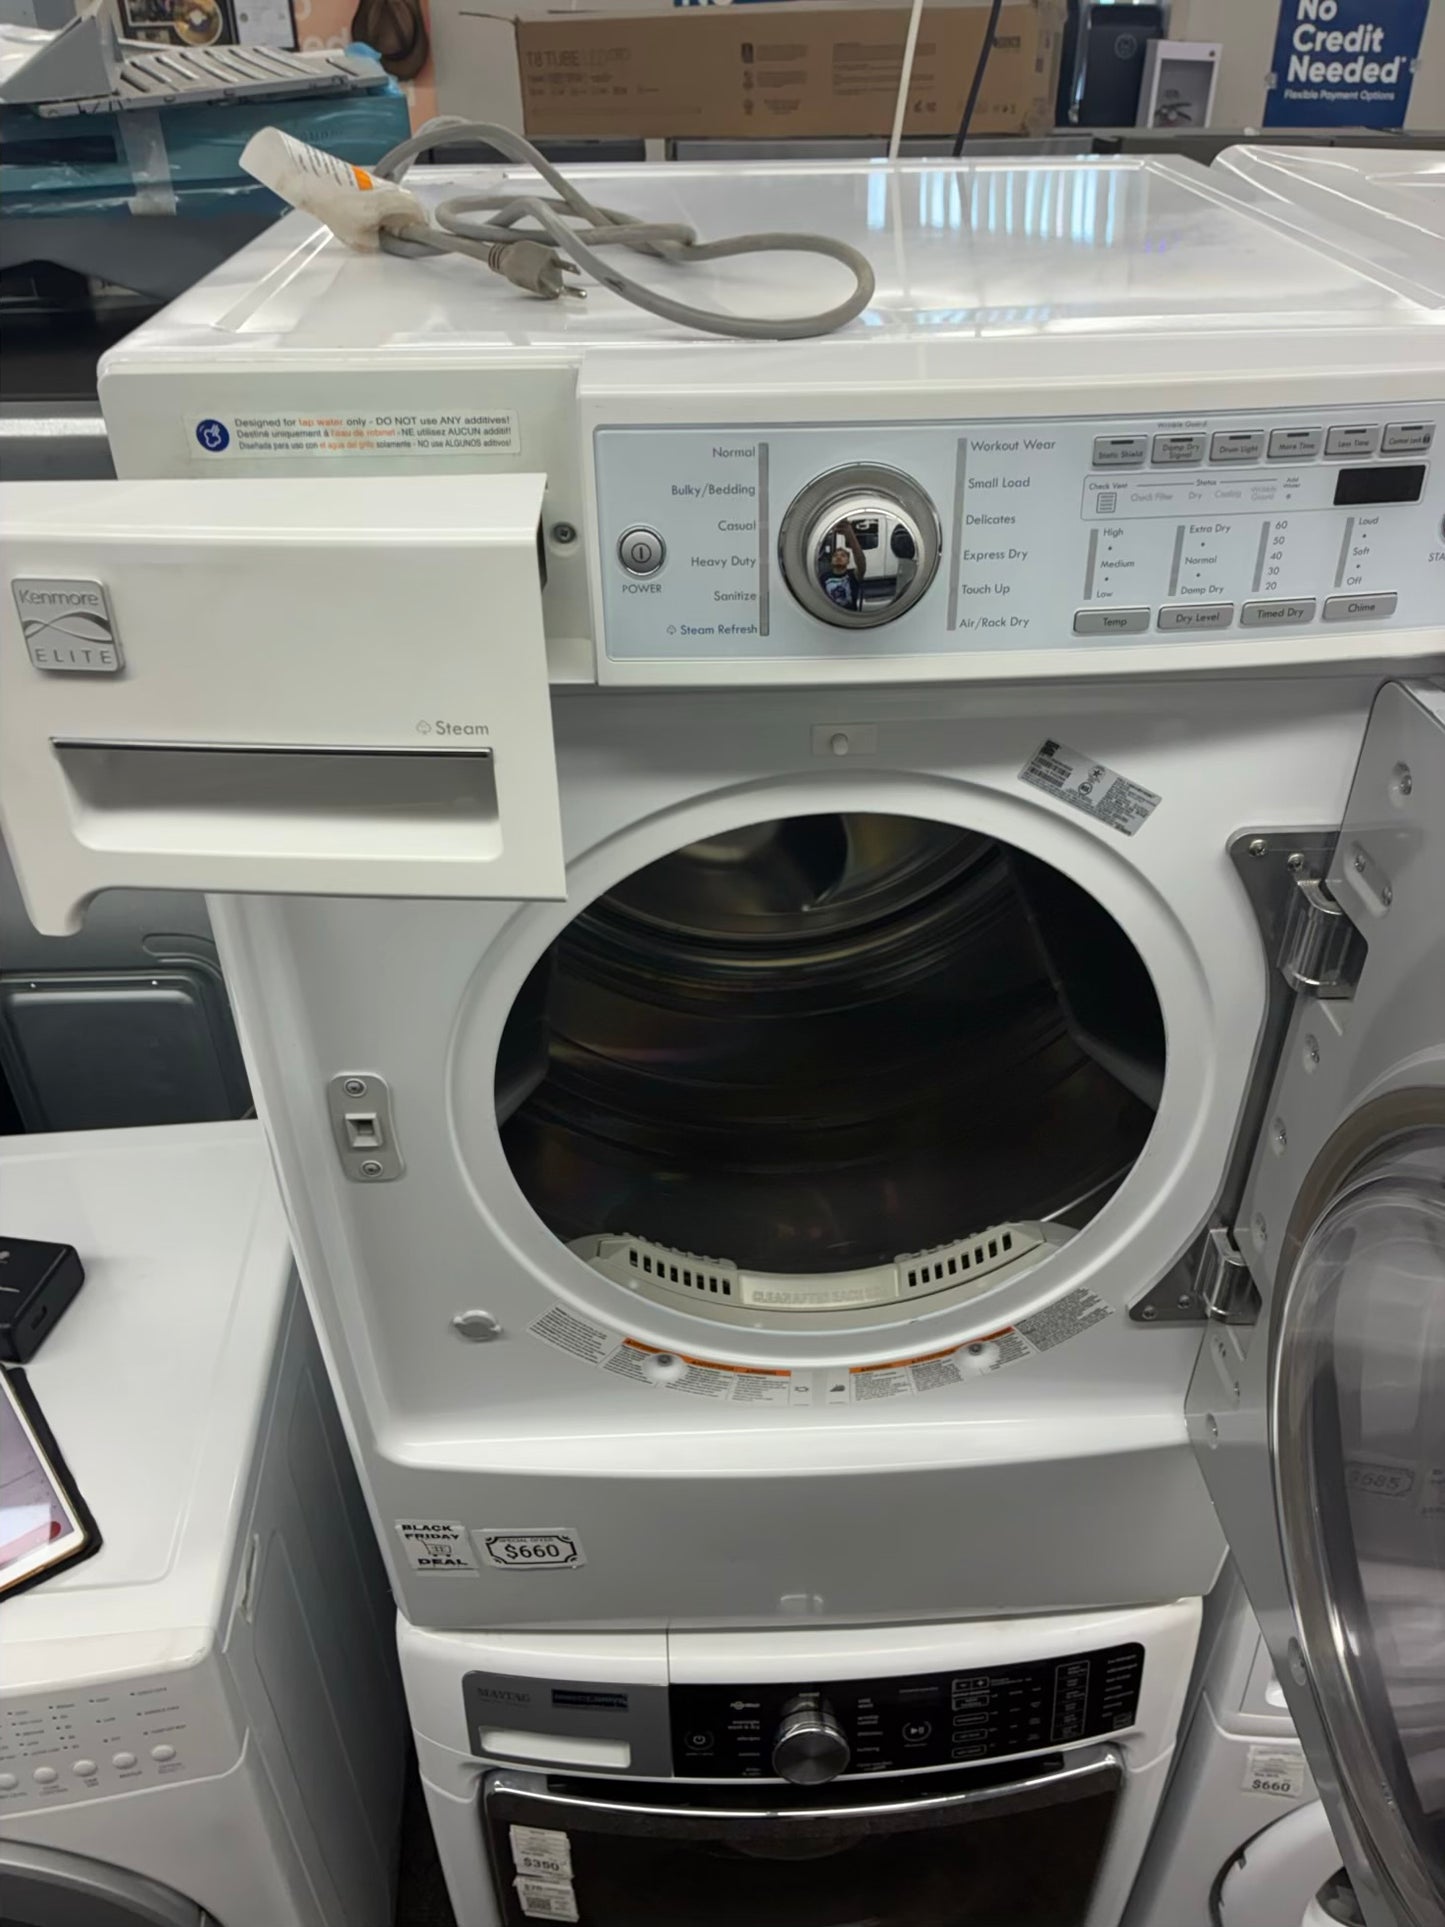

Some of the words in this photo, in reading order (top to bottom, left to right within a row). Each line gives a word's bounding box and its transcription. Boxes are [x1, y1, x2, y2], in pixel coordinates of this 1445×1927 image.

[1297, 0, 1338, 21] No
[1293, 23, 1384, 52] Credit
[544, 50, 580, 66] TUBE
[1284, 89, 1319, 100] Flexible
[1320, 90, 1359, 102] Payment
[1360, 90, 1395, 102] Options
[235, 418, 281, 428] Designed
[283, 418, 296, 427] for
[298, 418, 315, 428] tap
[317, 418, 343, 427] water
[346, 417, 366, 428] only
[376, 416, 392, 425] DO
[395, 416, 417, 425] NOT
[420, 417, 438, 425] use
[440, 416, 462, 425] ANY
[464, 415, 510, 425] additives!
[272, 430, 321, 440] uniquement
[353, 429, 365, 437] de
[401, 428, 414, 436] NE
[417, 428, 445, 437] utilisez
[448, 428, 481, 436] AUCUN
[273, 442, 289, 451] para
[376, 440, 411, 448] solamente
[418, 440, 429, 448] NO
[445, 439, 482, 448] ALGUNOS
[971, 438, 1019, 452] Workout
[1021, 438, 1057, 451] Wear
[1163, 444, 1185, 453] Damp
[1187, 443, 1200, 452] Dry
[1300, 441, 1315, 450] Time
[1338, 440, 1351, 448] Less
[1354, 439, 1369, 447] Time
[713, 446, 756, 458] Normal
[1099, 451, 1119, 460] Static
[1121, 450, 1143, 459] Shield
[1219, 446, 1239, 454] Drum
[1241, 445, 1258, 455] Light
[1169, 451, 1192, 461] Signal
[968, 477, 998, 489] Small
[1002, 476, 1031, 488] Load
[1089, 482, 1110, 490] Check
[1196, 478, 1217, 486] Status
[671, 483, 756, 498] Bulky/Bedding
[1188, 490, 1203, 501] Dry
[1214, 490, 1242, 499] Cooling
[1154, 492, 1174, 501] Filter
[966, 514, 1016, 526] Delicates
[1275, 521, 1288, 530] 60
[1358, 517, 1379, 526] Loud
[718, 520, 757, 532] Casual
[1189, 524, 1212, 534] Extra
[1214, 523, 1231, 534] Dry
[1103, 528, 1124, 538] High
[1272, 536, 1285, 545] 50
[963, 549, 1003, 563] Express
[1005, 548, 1029, 563] Dry
[1270, 551, 1282, 561] 40
[1353, 546, 1370, 556] Soft
[691, 556, 727, 570] Heavy
[730, 555, 757, 569] Duty
[1100, 560, 1135, 569] Medium
[1184, 556, 1217, 565] Normal
[1267, 567, 1280, 576] 30
[1265, 581, 1277, 591] 20
[1346, 577, 1362, 586] Off
[622, 583, 663, 594] POWER
[962, 584, 990, 595] Touch
[993, 583, 1011, 596] Up
[1180, 586, 1206, 596] Damp
[1208, 585, 1224, 596] Dry
[19, 588, 99, 607] Kenmore
[714, 590, 757, 602] Sanitize
[1096, 590, 1113, 599] Low
[1256, 609, 1284, 619] Timed
[1287, 607, 1304, 618] Dry
[1347, 603, 1375, 613] Chime
[959, 616, 1004, 631] Air/Rack
[1006, 615, 1030, 630] Dry
[1103, 617, 1127, 627] Temp
[1176, 614, 1193, 624] Dry
[1196, 612, 1220, 622] Level
[680, 624, 715, 636] Steam
[716, 623, 758, 635] Refresh
[35, 648, 112, 665] ELITE
[435, 720, 490, 736] Steam
[402, 1524, 452, 1532] BLACK
[405, 1533, 460, 1541] FRIDAY
[505, 1544, 560, 1560] $660
[418, 1558, 468, 1566] DEAL
[478, 1687, 531, 1703] MAYTAG
[1252, 1779, 1291, 1792] $660
[523, 1857, 560, 1872] $350
